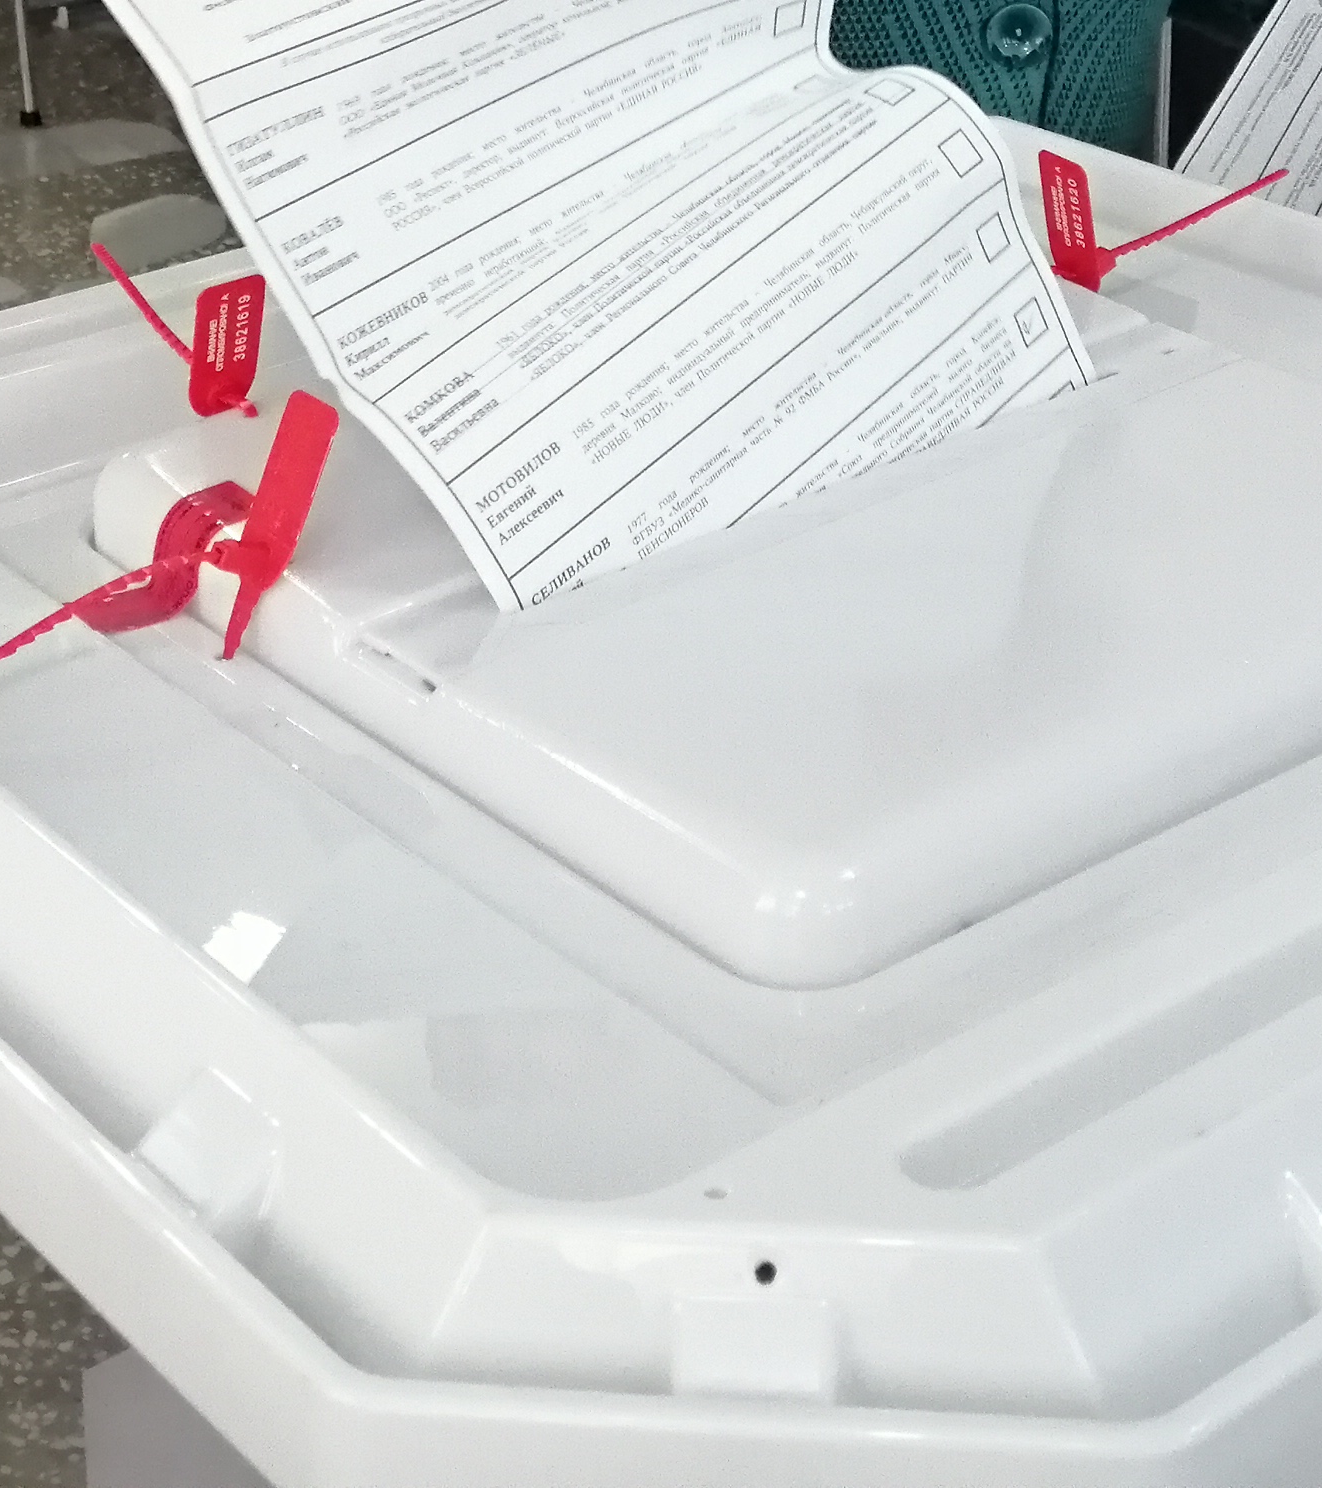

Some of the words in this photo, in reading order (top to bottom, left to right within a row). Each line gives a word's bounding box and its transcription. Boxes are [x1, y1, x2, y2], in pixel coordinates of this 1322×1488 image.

[463, 157, 525, 195] Всероссийской
[526, 126, 582, 162] политической
[478, 235, 522, 266] рождения;
[528, 217, 553, 237] место
[560, 189, 604, 218] жительства
[1067, 178, 1086, 248] 38621620
[560, 273, 621, 319] Политическая
[625, 248, 657, 274] партия
[659, 209, 710, 249] «Российская
[590, 261, 617, 284] место
[593, 266, 654, 314] Политической
[654, 245, 683, 270] партии
[683, 209, 733, 248] «Российская
[606, 274, 668, 323] Регионального
[668, 251, 699, 276] Совета
[699, 210, 755, 253] Челябинского
[233, 294, 251, 362] 38621619
[337, 291, 429, 349] КОЖЕВНИКОВ
[572, 417, 595, 440] 1985
[599, 399, 621, 419] года
[624, 360, 670, 401] рождения;
[673, 337, 699, 362] место
[702, 298, 750, 338] жительства
[763, 247, 815, 289] Челябинская
[817, 220, 852, 248] область,
[850, 174, 908, 221] Чебаркульский
[581, 421, 617, 454] деревня
[620, 385, 663, 421] Малково;
[666, 328, 736, 386] индивидуальный
[814, 235, 854, 270] выдвинут:
[857, 190, 912, 235] Политическая
[914, 167, 942, 191] партия
[345, 335, 391, 367] Кирилл
[354, 329, 429, 381] Максимович
[590, 430, 632, 465] «НОВЫЕ
[633, 399, 674, 433] ЛЮДИ»,
[673, 379, 696, 399] член
[695, 331, 756, 382] Политической
[756, 307, 786, 335] партии
[787, 275, 826, 310] «НОВЫЕ
[826, 250, 860, 278] ЛЮДИ»
[404, 370, 475, 423] КОМКОВА
[417, 387, 481, 437] Валентина
[430, 397, 499, 452] Васильевна
[795, 458, 839, 499] жительства
[856, 401, 904, 443] Челябинская
[944, 346, 967, 369] город
[888, 415, 925, 449] Собрания
[925, 373, 973, 416] Челябинской
[928, 407, 954, 432] партия
[954, 348, 1016, 408] СПРАВЕДЛИВАЯ
[626, 511, 648, 535] 1977
[657, 489, 678, 510] года
[688, 444, 731, 484] рождения;
[741, 414, 766, 439] место
[773, 371, 818, 411] жительства
[631, 515, 666, 547] ФГБУЗ
[667, 446, 749, 518] «Медико-санитарная
[749, 426, 773, 448] часть
[772, 415, 785, 429] №
[797, 379, 826, 406] ФМБА
[837, 453, 863, 478] «Союз
[871, 386, 939, 448] предпринимателей
[475, 441, 561, 513] МОТОВИЛОВ
[486, 484, 536, 528] Евгений
[498, 488, 564, 545] Алексеевич
[637, 496, 709, 560] ПЕНСИОНЕРОВ
[530, 537, 611, 606] СЕЛИВАНОВ
